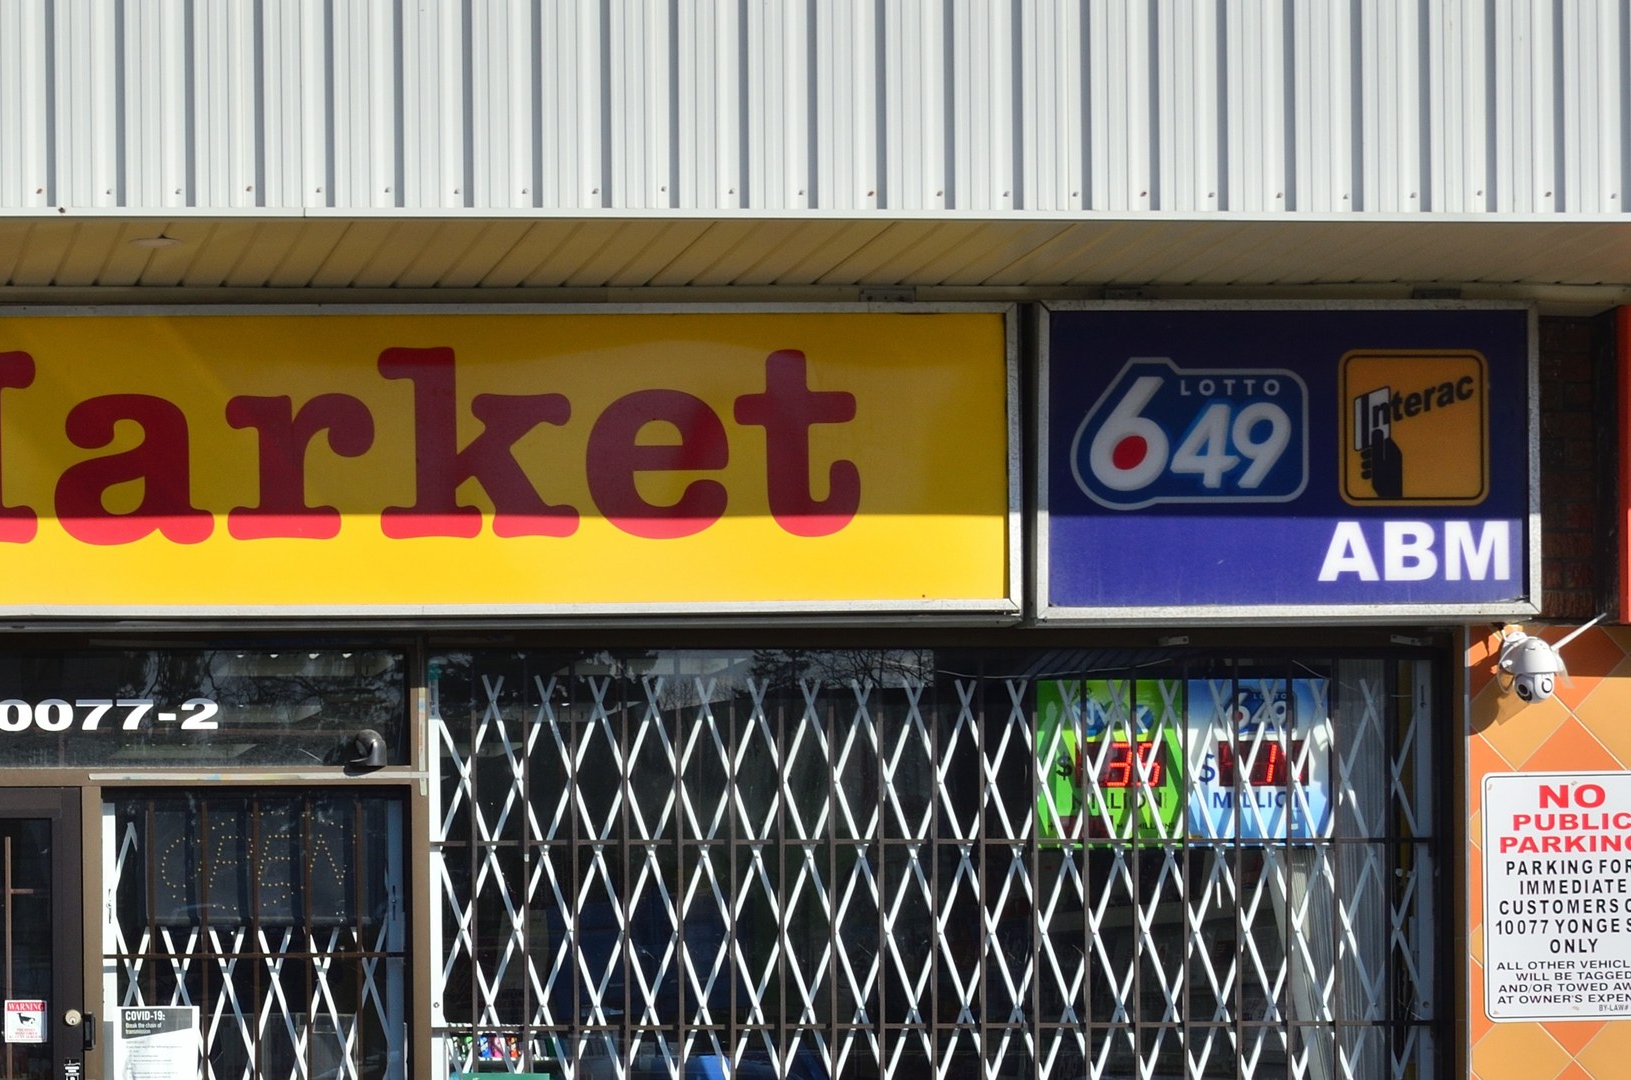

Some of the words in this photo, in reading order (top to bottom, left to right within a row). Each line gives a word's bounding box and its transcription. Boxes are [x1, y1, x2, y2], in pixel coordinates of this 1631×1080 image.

[1180, 378, 1280, 397] LOTTO
[1368, 375, 1475, 430] Interac
[1089, 375, 1293, 491] 649
[1317, 520, 1511, 582] ABM
[1538, 783, 1606, 809] NO
[1512, 813, 1631, 831] PUBLIC
[1499, 835, 1631, 854] PARKIN
[1506, 860, 1593, 876] PARKING
[1519, 879, 1627, 895] IMMEDIATE
[1499, 898, 1619, 915] CUSTOMERS
[1496, 919, 1549, 935] 10077
[1555, 918, 1620, 934] YONGE
[1550, 938, 1598, 954] ONLY
[1496, 961, 1523, 971] ALL
[1528, 960, 1575, 970] OTHER
[1580, 959, 1631, 969] VEHICL
[1515, 972, 1550, 981] WILL
[1554, 971, 1572, 981] BE
[1498, 983, 1552, 993] AND/OR
[1557, 982, 1608, 992] TOWED
[8, 1002, 45, 1011] WARNING
[1497, 995, 1514, 1005] AT
[1519, 994, 1583, 1004] OWNER'S
[1588, 993, 1631, 1003] EXPEN
[125, 1010, 166, 1021] COVID-19:
